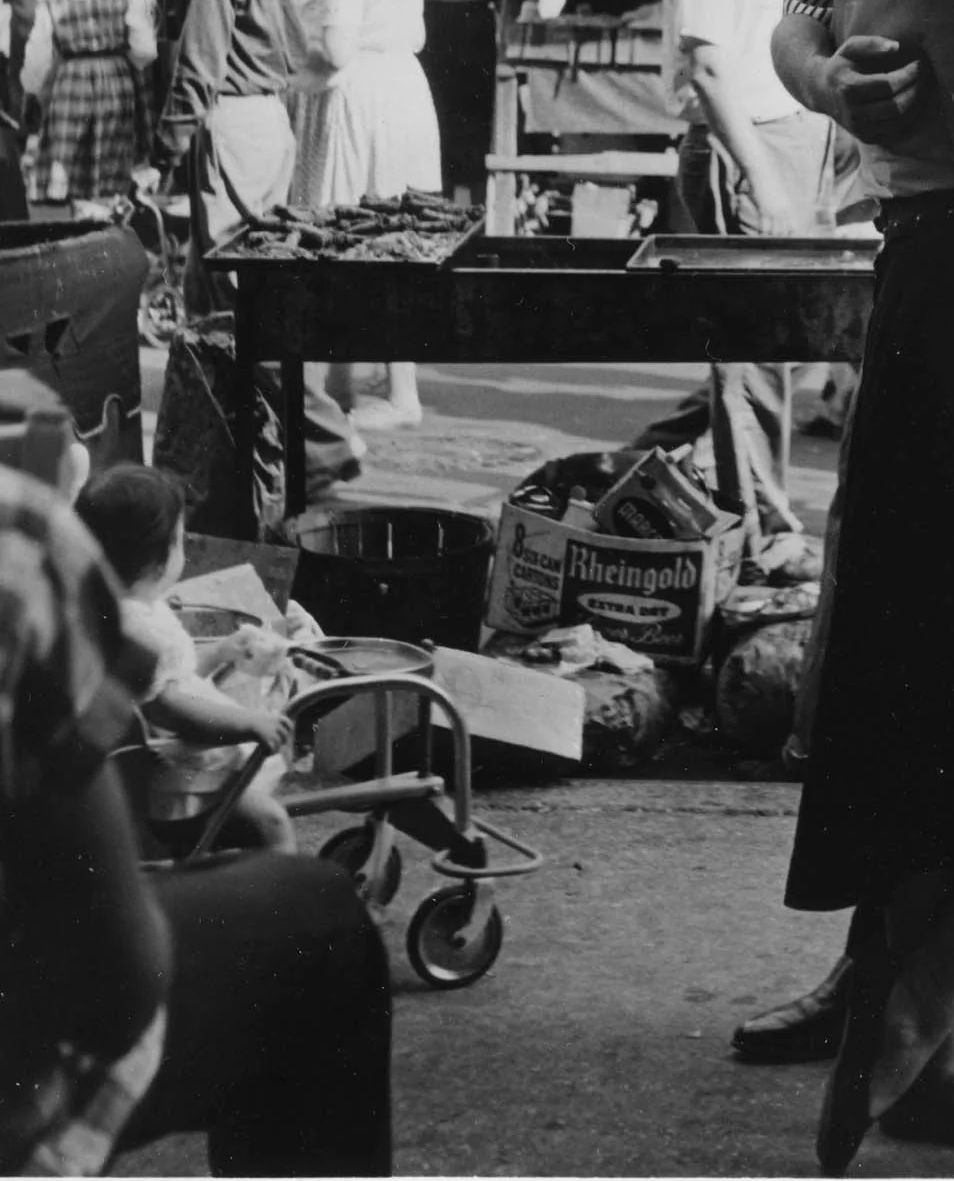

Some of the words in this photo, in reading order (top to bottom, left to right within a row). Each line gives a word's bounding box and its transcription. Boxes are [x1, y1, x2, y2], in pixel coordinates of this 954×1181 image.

[513, 522, 526, 557] 8
[513, 563, 560, 592] CARTONS
[568, 544, 697, 596] Rheingold
[587, 598, 635, 615] EXTRA
[639, 606, 670, 618] DRY
